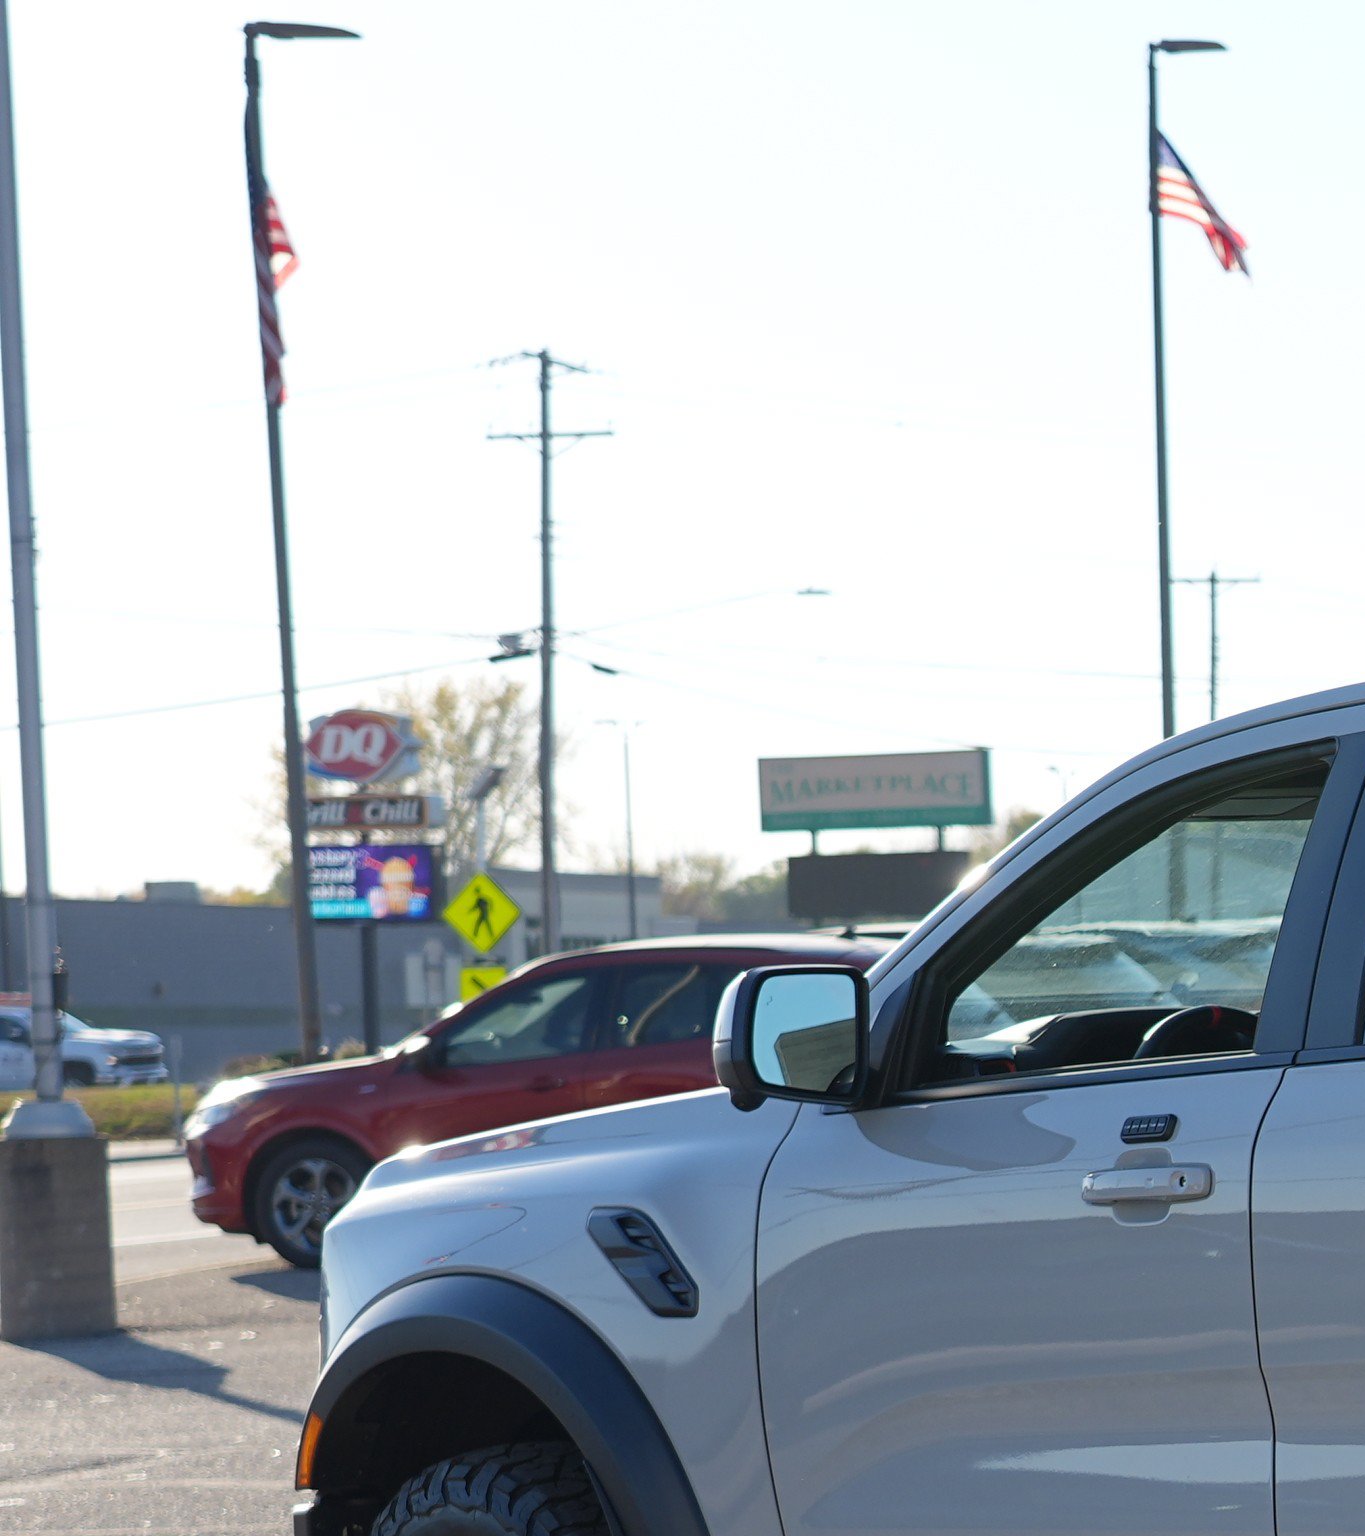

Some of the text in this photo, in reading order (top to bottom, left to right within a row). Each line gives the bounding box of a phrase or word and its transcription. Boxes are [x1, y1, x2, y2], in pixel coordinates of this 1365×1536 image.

[320, 724, 387, 767] DQ
[769, 772, 970, 805] MARKETPLACE
[305, 801, 419, 826] rill Chill
